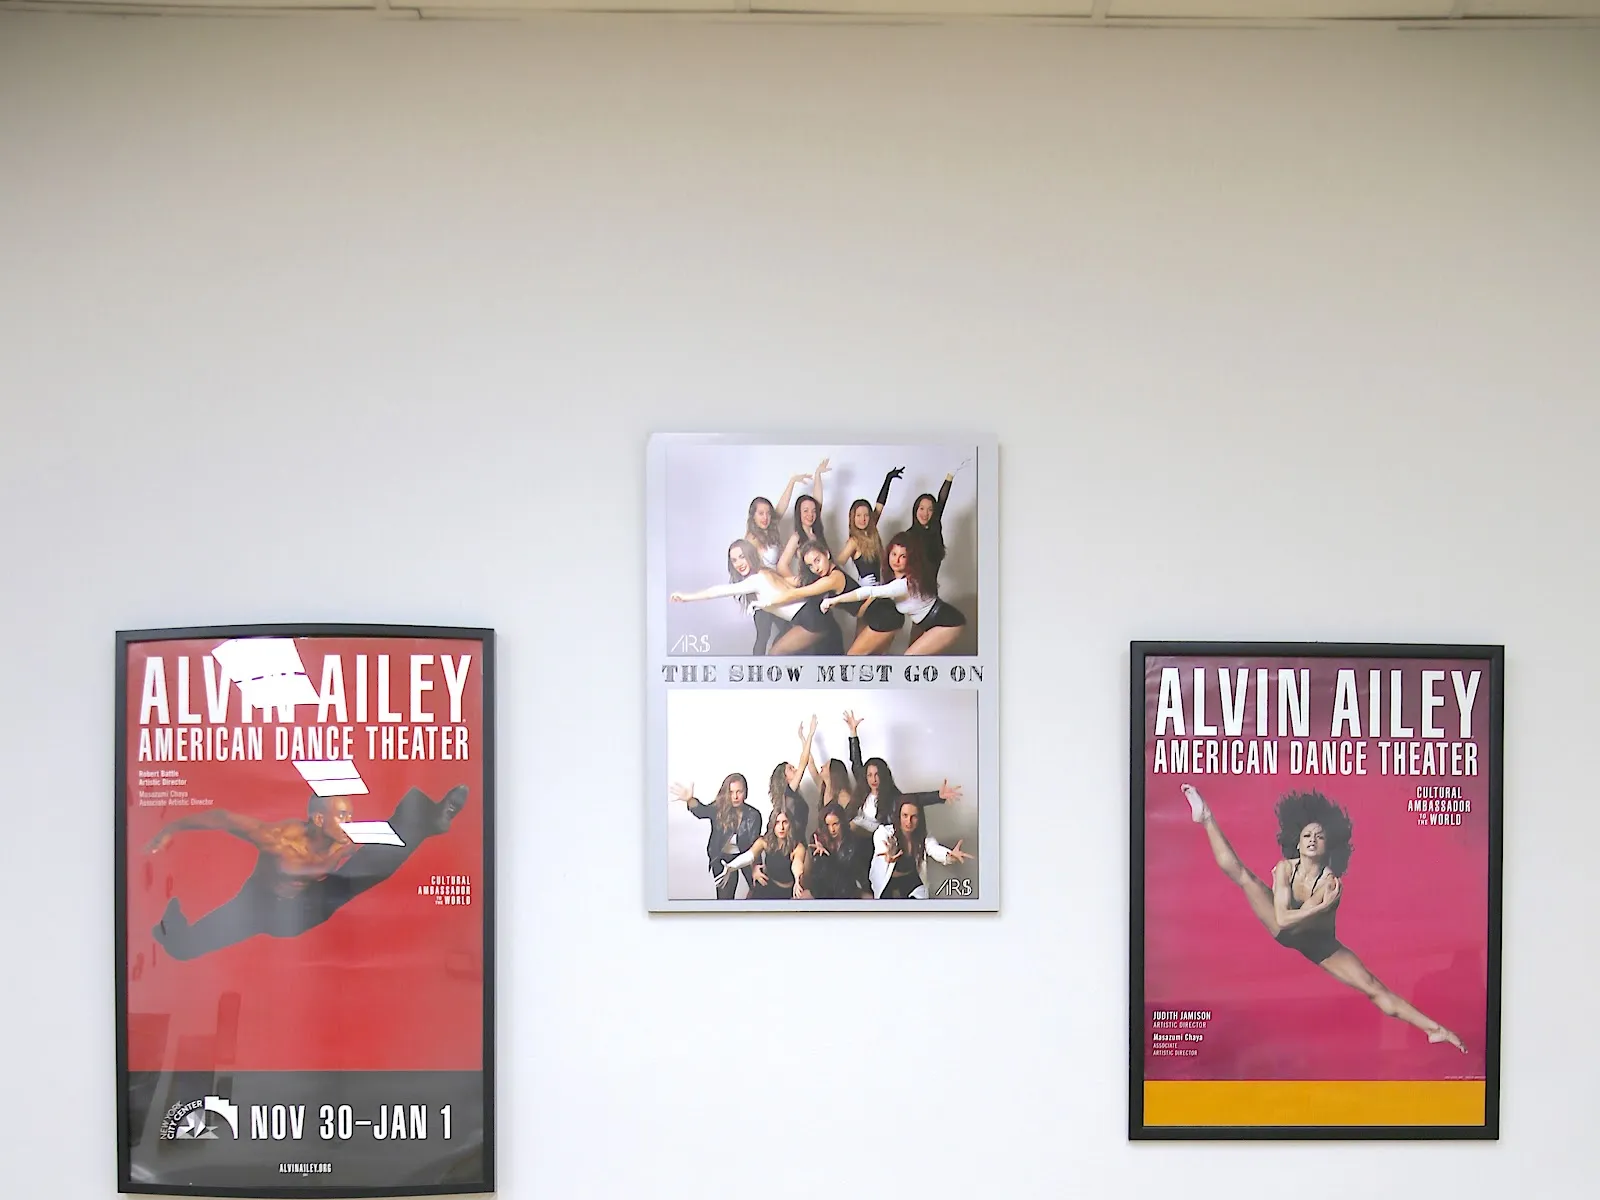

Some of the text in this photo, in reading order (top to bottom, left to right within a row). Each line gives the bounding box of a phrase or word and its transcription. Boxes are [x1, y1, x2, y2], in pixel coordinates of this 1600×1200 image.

[661, 664, 985, 683] THE SHOW MUST GO ON
[139, 653, 472, 724] ALV AILEY
[1154, 667, 1482, 739] ALVIN AILEY
[138, 725, 469, 761] AMERICAN DANCE THEATER
[1153, 739, 1479, 776] AMERICAN DANCE THEATER
[1416, 786, 1463, 799] CULTURAL
[1407, 799, 1471, 812] AMBASSADOR
[1429, 813, 1462, 825] WORLD
[431, 875, 471, 885] CULTURAL
[417, 885, 471, 895] AMBASSADOR
[444, 895, 471, 905] WORLD
[1153, 1011, 1211, 1020] JUDITH JAMISON
[1153, 1033, 1203, 1042] Masazumi Chaya
[160, 1101, 183, 1140] NEW YORK
[167, 1100, 203, 1140] CITY CENTER
[250, 1104, 306, 1140] NOV
[440, 1105, 452, 1140] 1
[279, 1163, 332, 1173] ALVINAILEY.ORG
